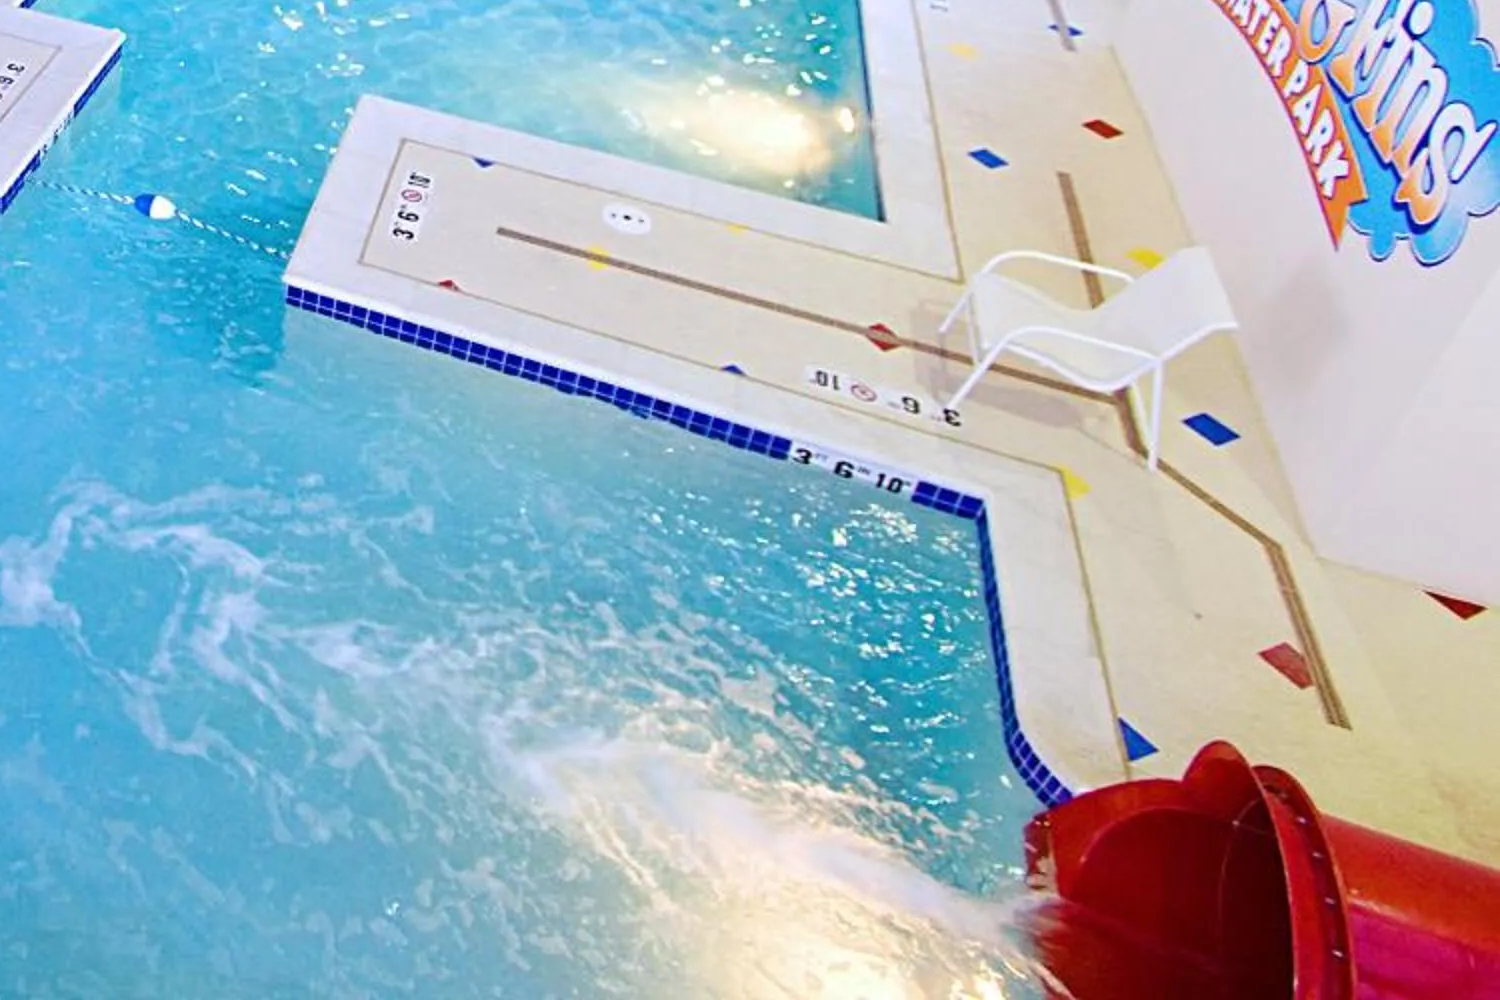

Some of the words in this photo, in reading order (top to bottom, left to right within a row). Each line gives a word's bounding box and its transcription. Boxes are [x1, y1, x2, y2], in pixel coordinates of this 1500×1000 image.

[1283, 58, 1350, 199] PARK
[398, 211, 419, 222] 6
[393, 227, 415, 240] 3
[902, 396, 921, 414] 6
[943, 408, 962, 427] 3
[792, 448, 813, 465] 3
[833, 461, 855, 479] 6
